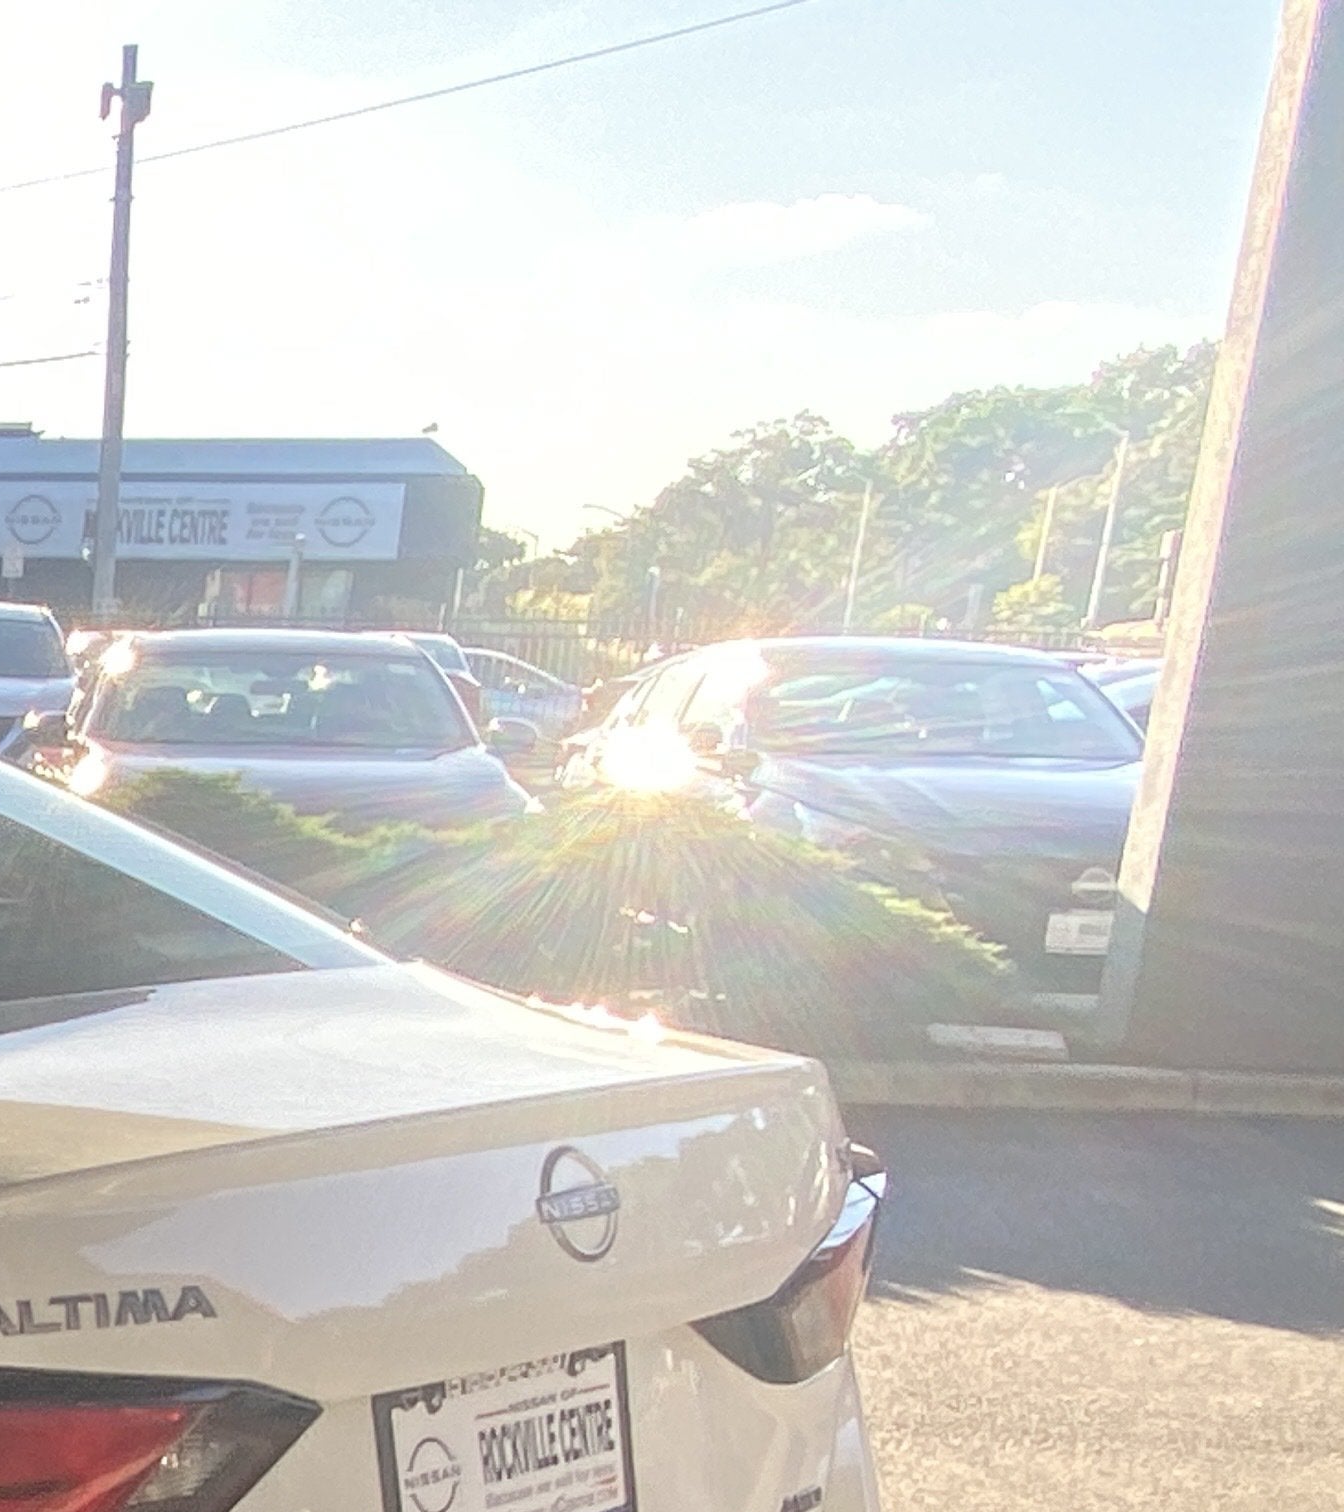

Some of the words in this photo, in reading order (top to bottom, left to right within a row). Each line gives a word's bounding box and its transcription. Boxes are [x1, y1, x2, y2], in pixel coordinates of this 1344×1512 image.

[170, 508, 229, 544] CENTRE
[478, 1413, 560, 1485] ROCKVILLE
[559, 1399, 615, 1462] CENTRE
[404, 1464, 462, 1490] NISSAN
